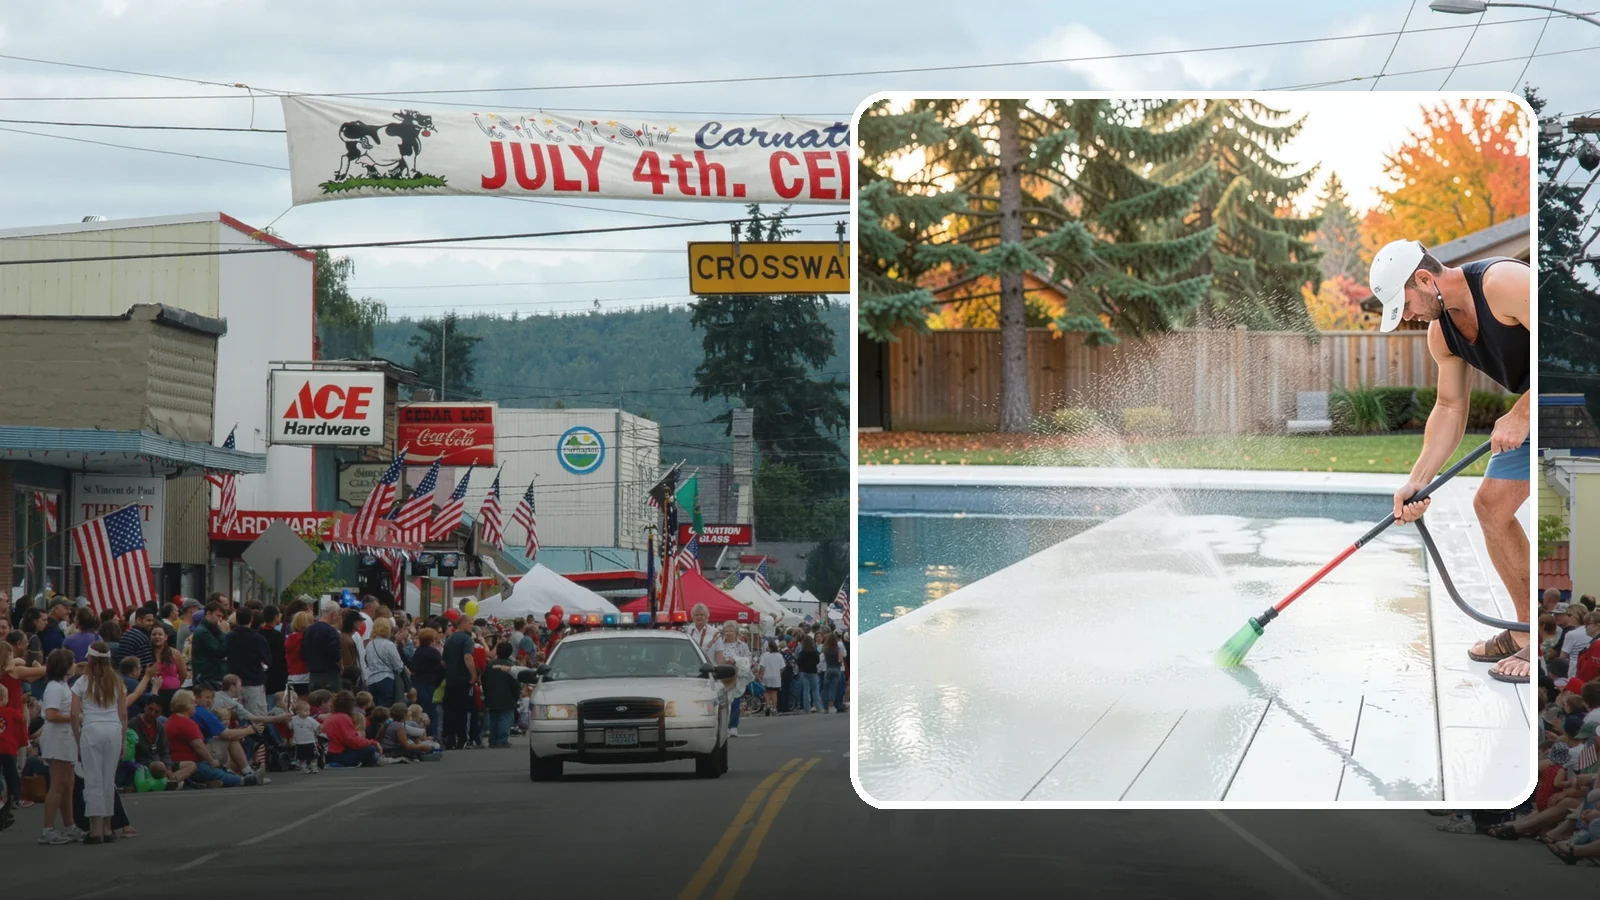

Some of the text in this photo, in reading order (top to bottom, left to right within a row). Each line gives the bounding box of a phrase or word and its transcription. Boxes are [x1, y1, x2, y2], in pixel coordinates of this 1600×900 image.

[481, 141, 605, 193] JULY
[632, 150, 746, 198] 4th.
[697, 254, 850, 280] CROSSWA
[283, 380, 373, 420] ACE
[406, 409, 485, 421] CEDAR LOG
[284, 421, 371, 436] Hardware
[416, 428, 476, 447] Coca-Cola
[95, 485, 124, 495] Vincent
[126, 486, 136, 495] de
[137, 486, 155, 495] Paul
[688, 526, 741, 535] CRNATION
[699, 535, 730, 543] GLASS
